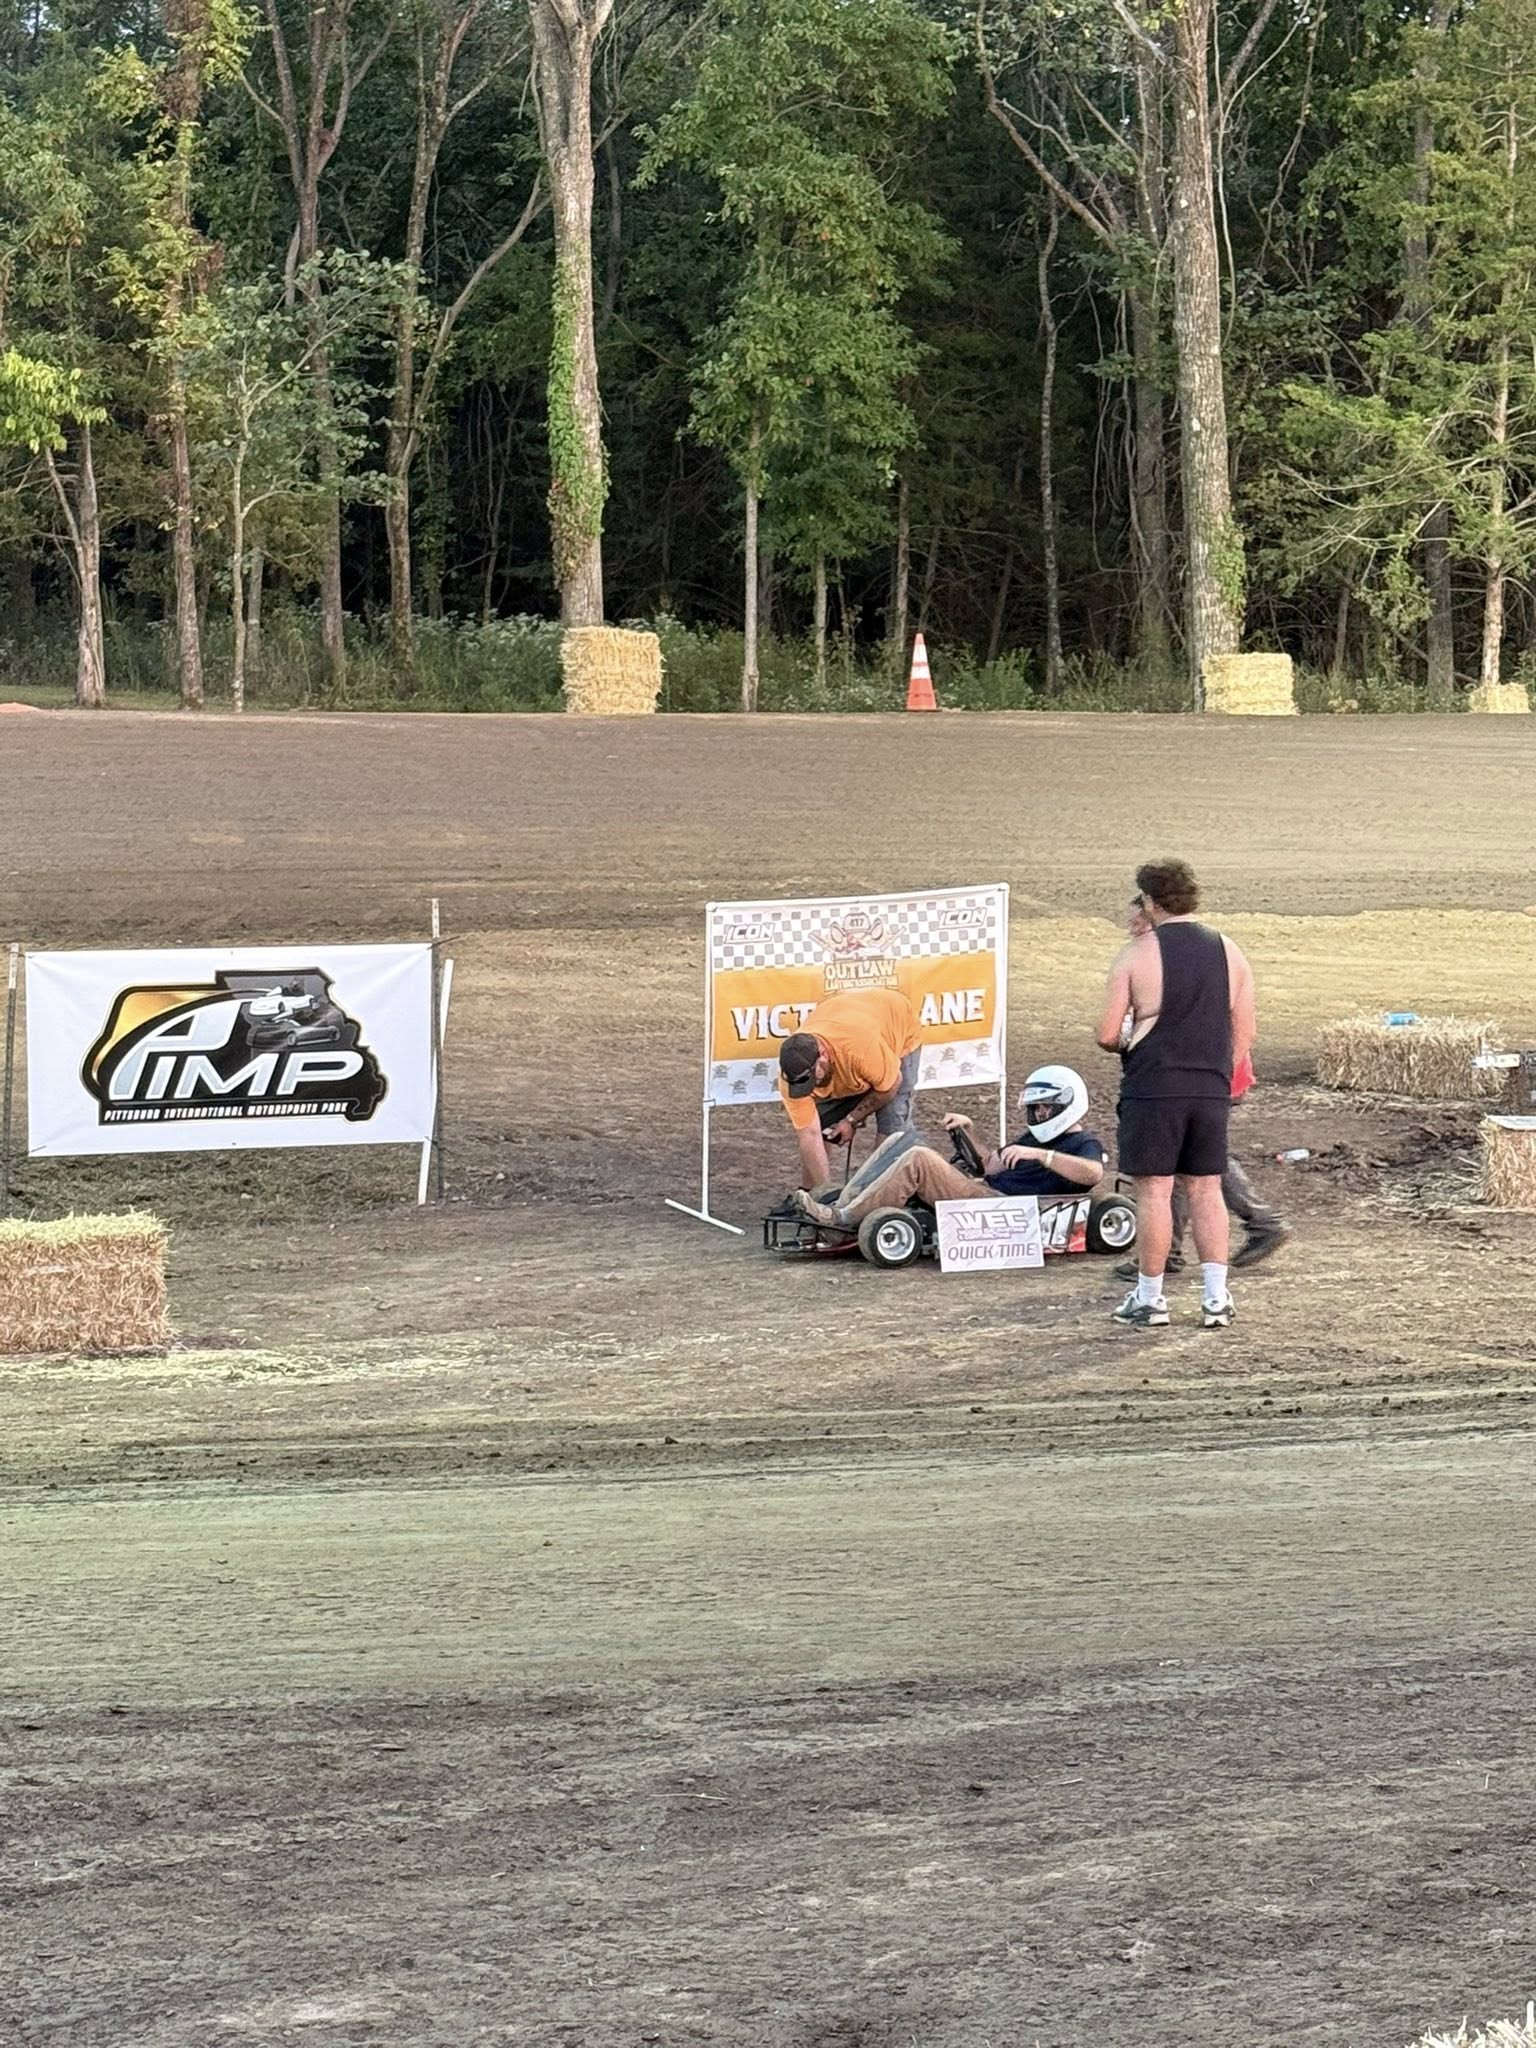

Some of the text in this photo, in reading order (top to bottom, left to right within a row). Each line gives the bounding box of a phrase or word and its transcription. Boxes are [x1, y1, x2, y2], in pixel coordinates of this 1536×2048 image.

[938, 907, 988, 929] ICON
[724, 922, 775, 943] ICON
[824, 959, 896, 980] OUTLAW
[732, 989, 986, 1040] VICT ANE
[164, 1106, 243, 1119] INTERNATIONAL
[247, 1103, 318, 1117] MOTORSPORTS
[321, 1102, 349, 1113] PARK
[947, 1242, 1036, 1261] QUICK TIME
